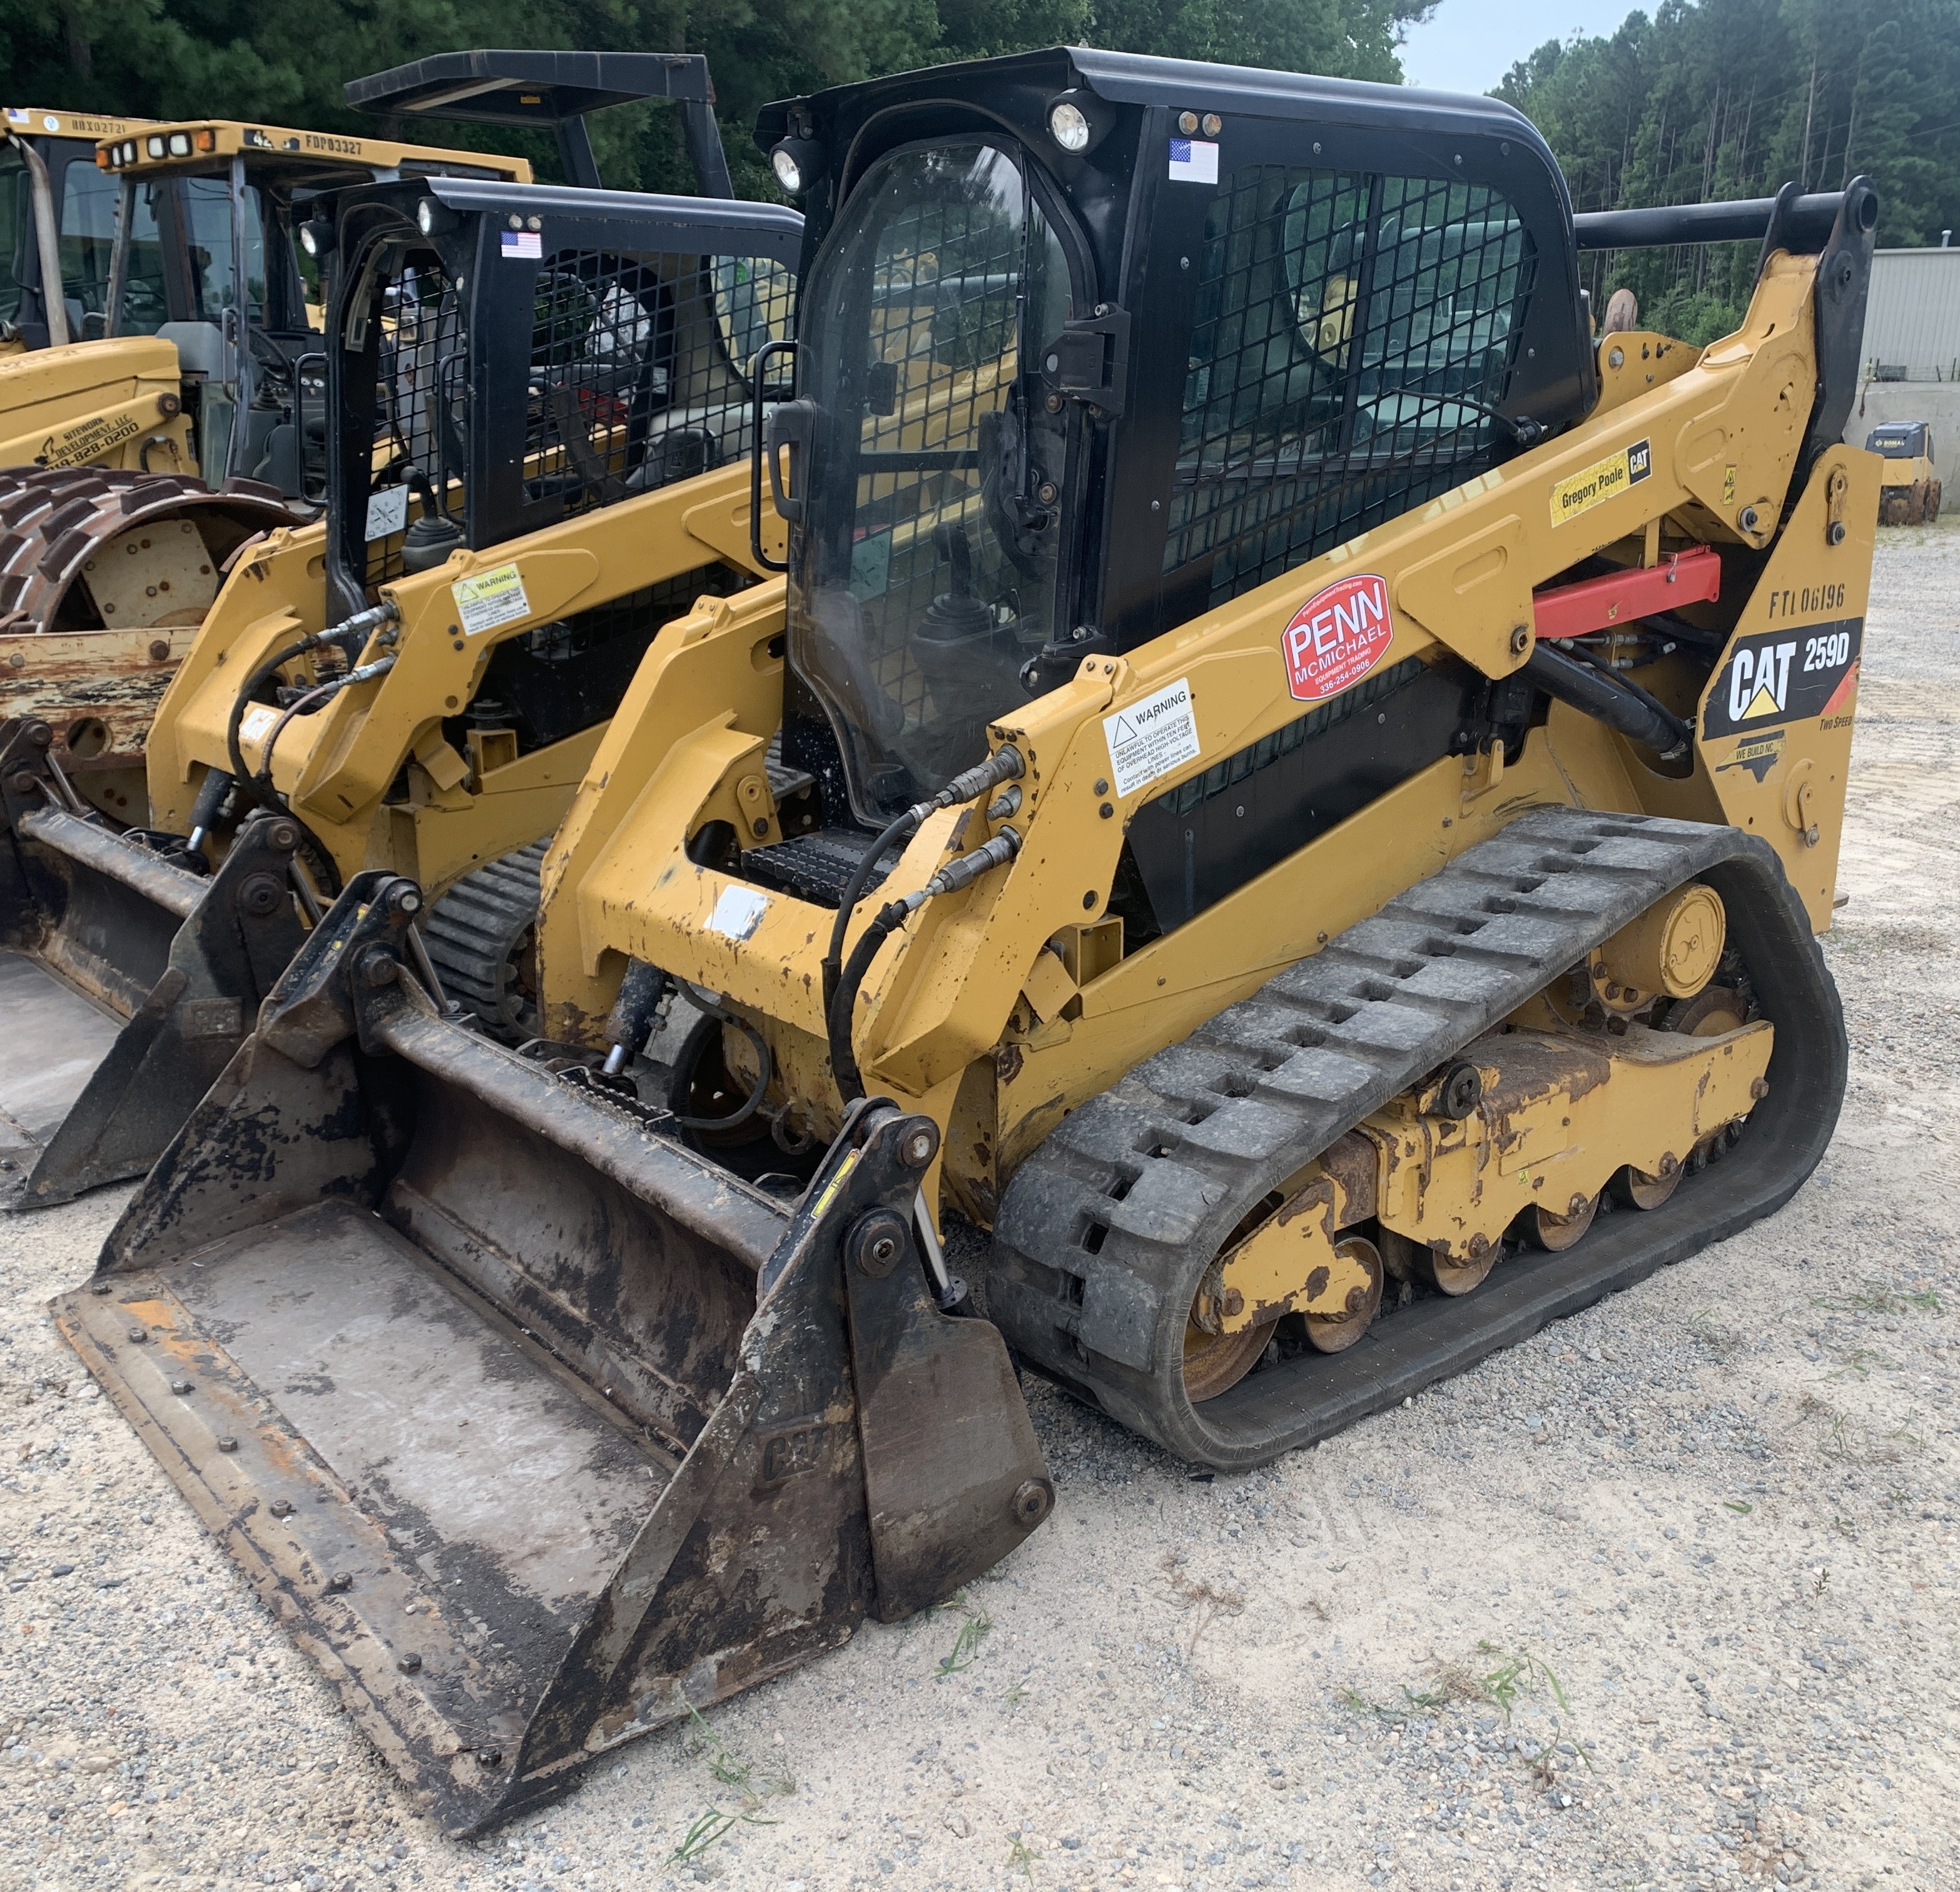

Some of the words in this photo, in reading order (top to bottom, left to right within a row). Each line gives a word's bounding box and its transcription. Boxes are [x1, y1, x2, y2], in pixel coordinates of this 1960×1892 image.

[306, 135, 361, 155] FDP03327
[63, 417, 104, 441] SITEWORK
[1630, 448, 1649, 475] CAT
[1562, 483, 1597, 508] Gregory
[1598, 467, 1623, 490] Poole
[476, 571, 516, 590] WARNING
[1302, 581, 1363, 618] PennEquipmentTrading.com
[1289, 581, 1384, 669] PENN
[1294, 624, 1387, 685] MCMICHAEL
[1315, 662, 1346, 685] EQUIPMENT
[1346, 647, 1372, 666] TRADING
[1803, 632, 1850, 672] 259D
[1320, 659, 1370, 694] 336-254-0906
[1729, 641, 1797, 721] CAT
[1135, 691, 1186, 725] WARNING
[1115, 741, 1144, 758] UNLAWFUL
[1153, 723, 1177, 738] OPERATE
[1177, 715, 1189, 725] THIS
[1117, 745, 1147, 765] EQUIPMENT
[1147, 735, 1165, 748] WITHIN
[1166, 729, 1177, 739] TEN
[1177, 722, 1190, 734] FEET
[1126, 750, 1155, 768] OVERHEAD
[1155, 728, 1192, 751] HIGH-VOLTAGE
[1736, 749, 1746, 760] WE
[1747, 745, 1764, 758] BUILD
[1765, 743, 1774, 753] NC
[1121, 782, 1135, 793] result
[1142, 771, 1156, 781] death
[1163, 758, 1181, 770] serious
[1181, 748, 1196, 760] burns.
[1123, 771, 1142, 785] Contact
[1143, 764, 1154, 773] with
[1155, 757, 1169, 768] power
[1170, 749, 1182, 758] lines
[1147, 753, 1163, 764] LINES
